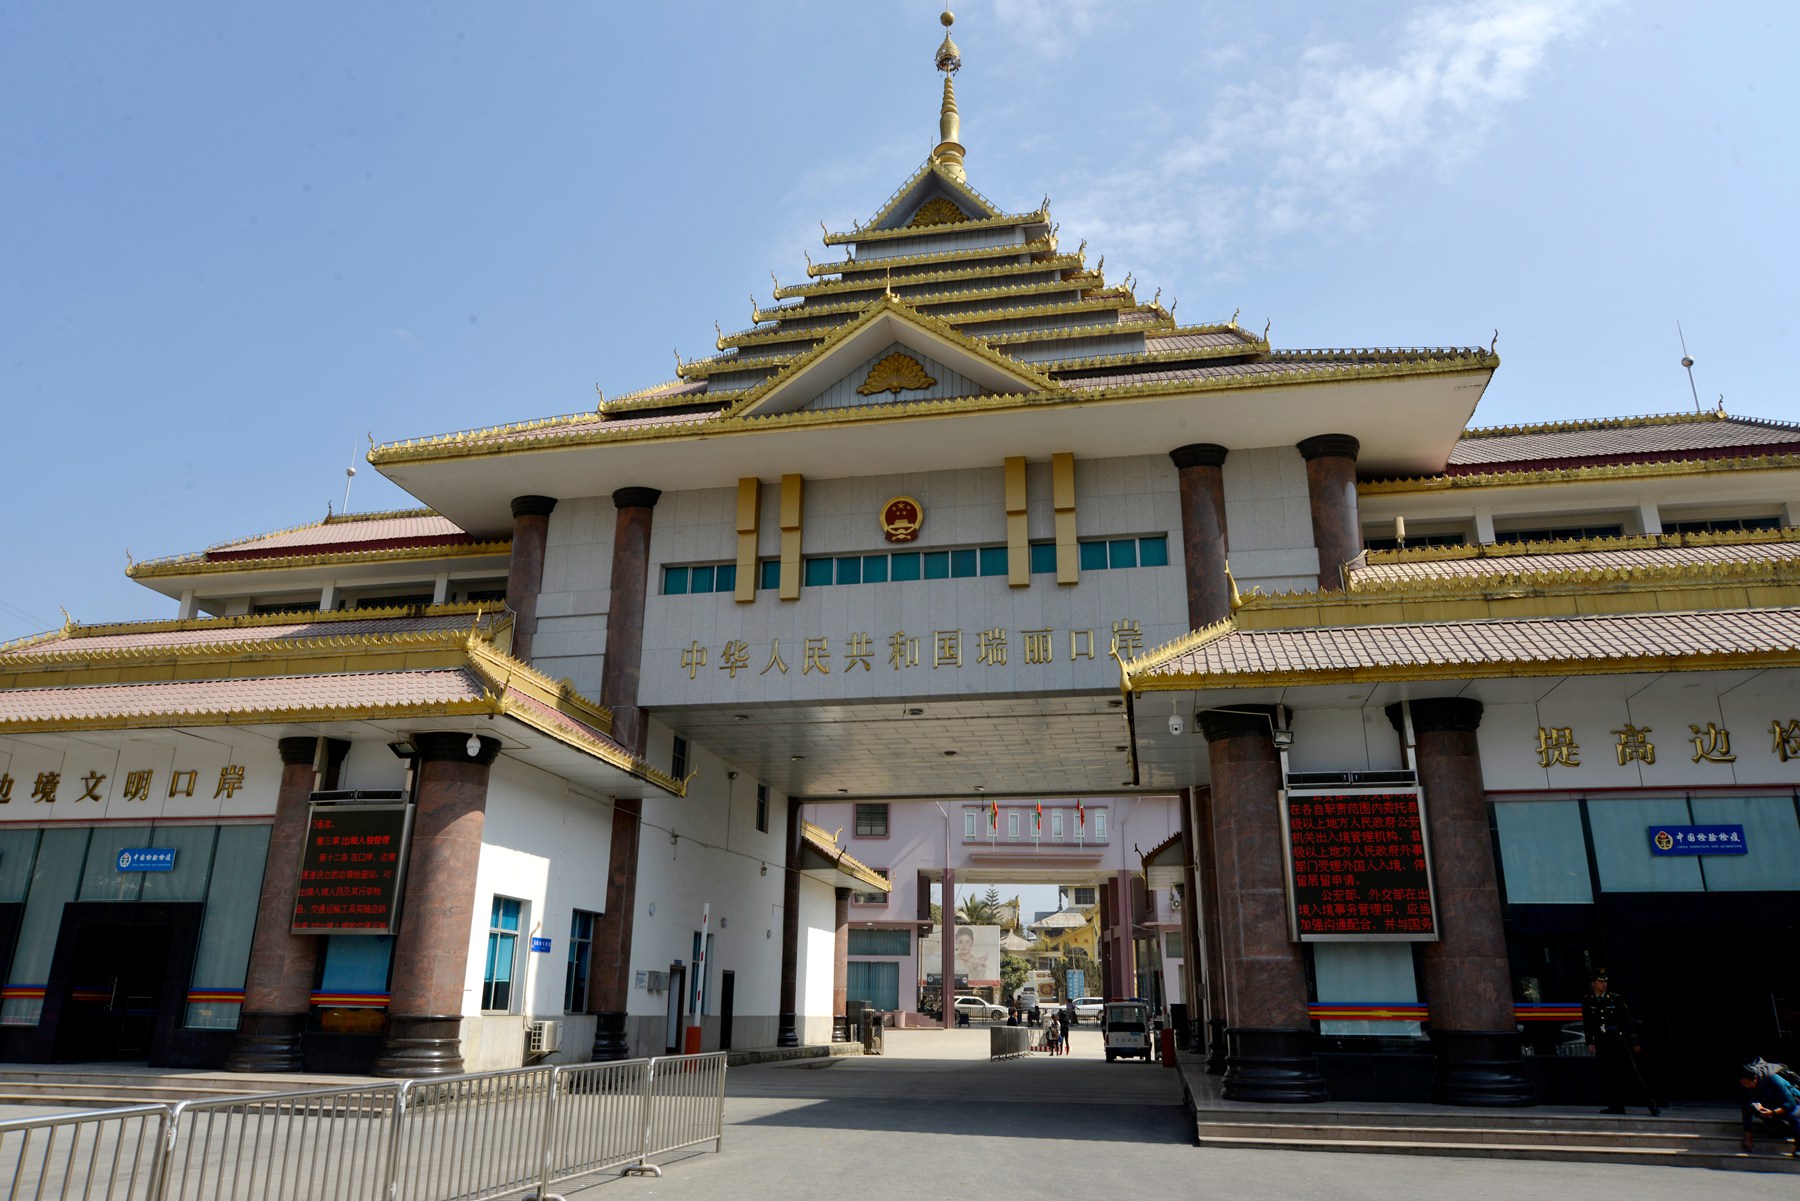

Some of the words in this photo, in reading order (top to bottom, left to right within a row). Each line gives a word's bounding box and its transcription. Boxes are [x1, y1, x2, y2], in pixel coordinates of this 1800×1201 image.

[680, 617, 1145, 680] 中华人民共和国瑞丽口岸
[1289, 802, 1417, 815] 在各自职责范围内委托县
[1291, 816, 1420, 829] 级以上地方人民政府公安
[1292, 830, 1421, 844] 机关出入境管理机构、县
[1676, 831, 1740, 843] 中国检验检疫
[1293, 844, 1423, 858] 级以上地方人民政府外事
[1295, 859, 1426, 872] 部门受理外国人入境、停
[1296, 874, 1360, 887] 留居留申请。
[1321, 888, 1429, 901] 公安部、外交部在出
